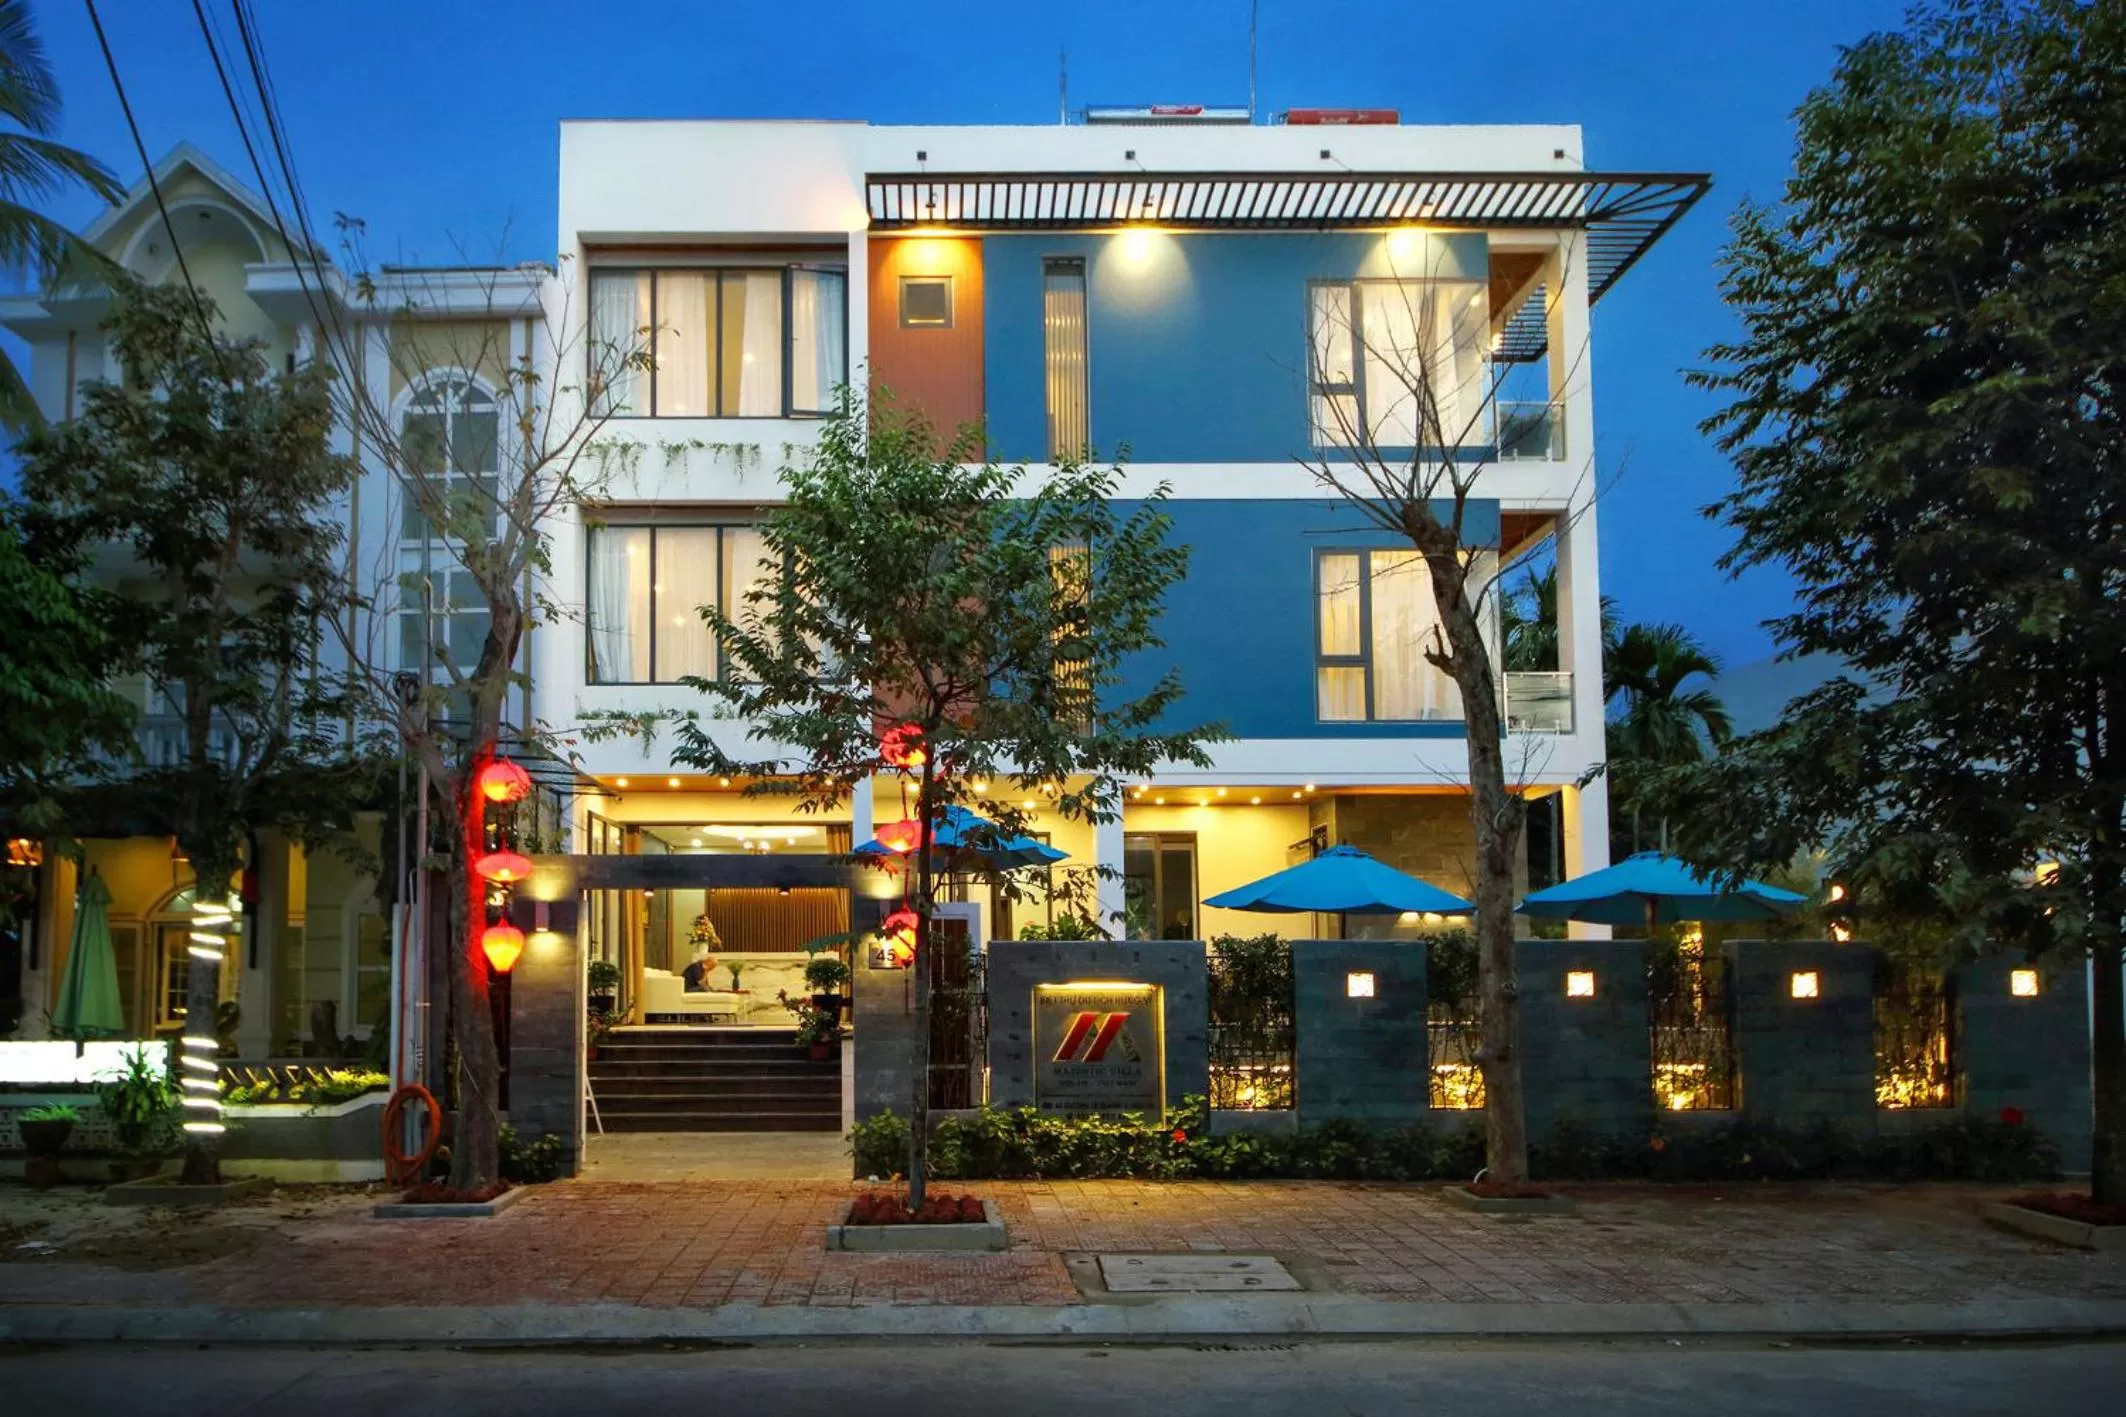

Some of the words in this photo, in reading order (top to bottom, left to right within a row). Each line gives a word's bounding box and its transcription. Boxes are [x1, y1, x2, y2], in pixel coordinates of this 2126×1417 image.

[876, 949, 895, 961] 45
[1053, 1066, 1104, 1076] MAJESTIC
[1110, 1066, 1142, 1076] VILLA
